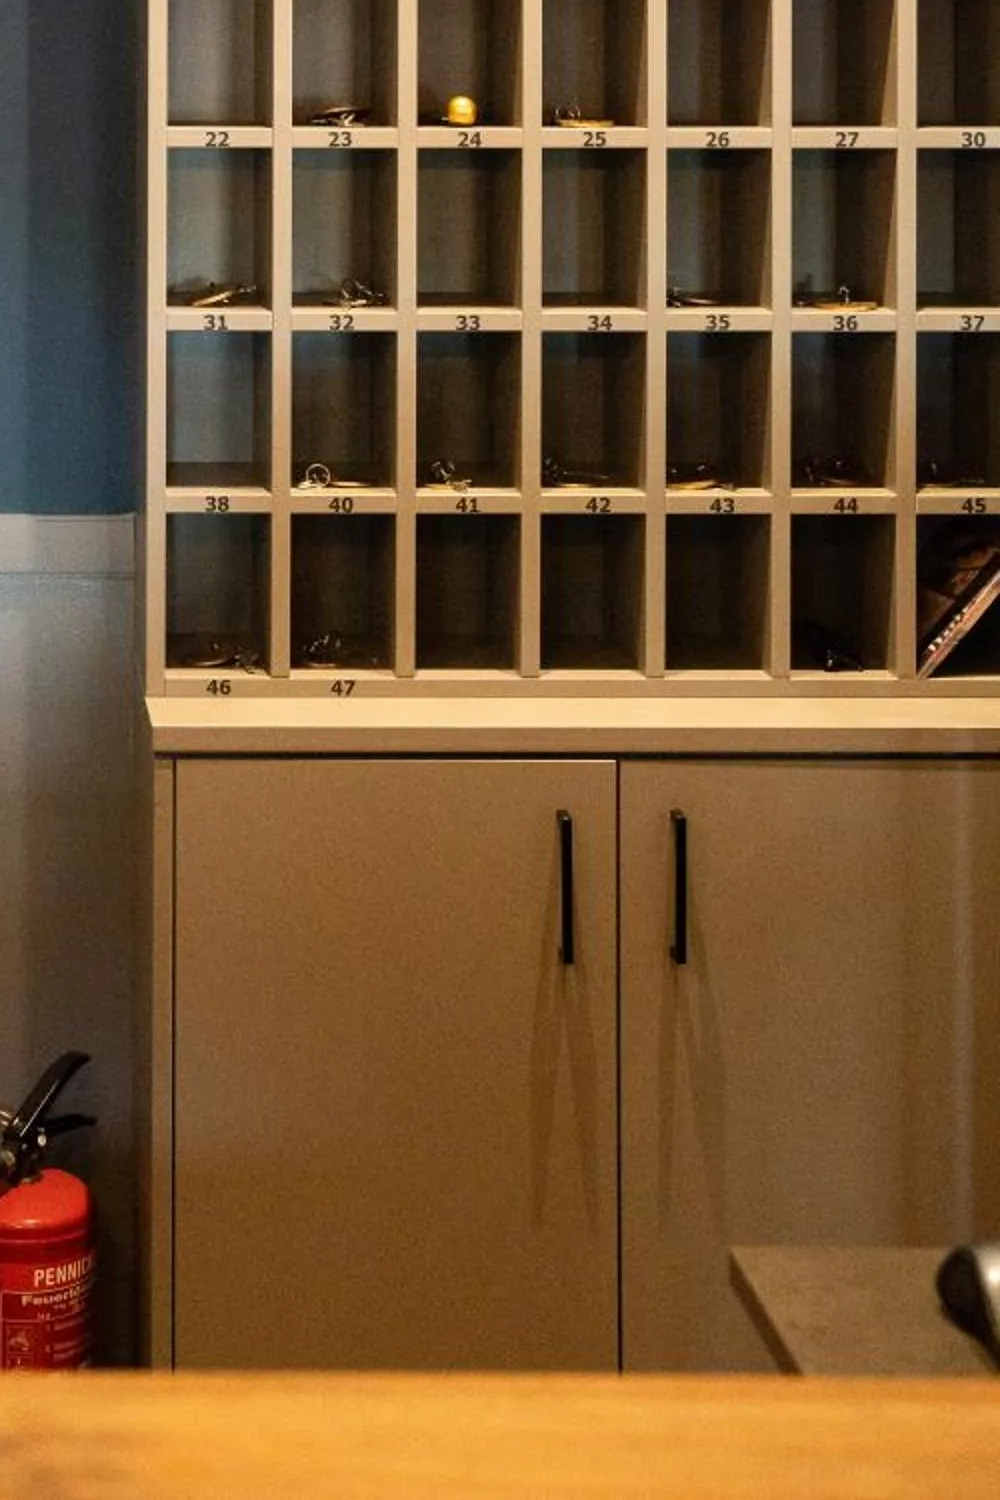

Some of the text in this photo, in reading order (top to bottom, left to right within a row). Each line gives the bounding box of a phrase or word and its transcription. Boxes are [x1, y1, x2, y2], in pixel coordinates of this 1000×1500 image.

[205, 131, 229, 148] 22
[328, 131, 353, 148] 23
[458, 131, 482, 148] 24
[583, 131, 607, 148] 25
[706, 131, 730, 148] 26
[835, 131, 859, 148] 27
[961, 131, 986, 148] 30
[204, 314, 228, 331] 31
[329, 314, 355, 331] 32
[456, 315, 481, 332] 33
[587, 315, 613, 332] 34
[706, 314, 731, 331] 35
[833, 315, 858, 332] 36
[961, 315, 985, 332] 37
[205, 496, 230, 513] 38
[329, 496, 354, 513] 40
[455, 497, 479, 514] 41
[585, 497, 611, 514] 42
[709, 497, 735, 514] 43
[833, 497, 858, 514] 44
[961, 497, 987, 514] 45
[206, 679, 232, 696] 46
[330, 679, 356, 696] 47
